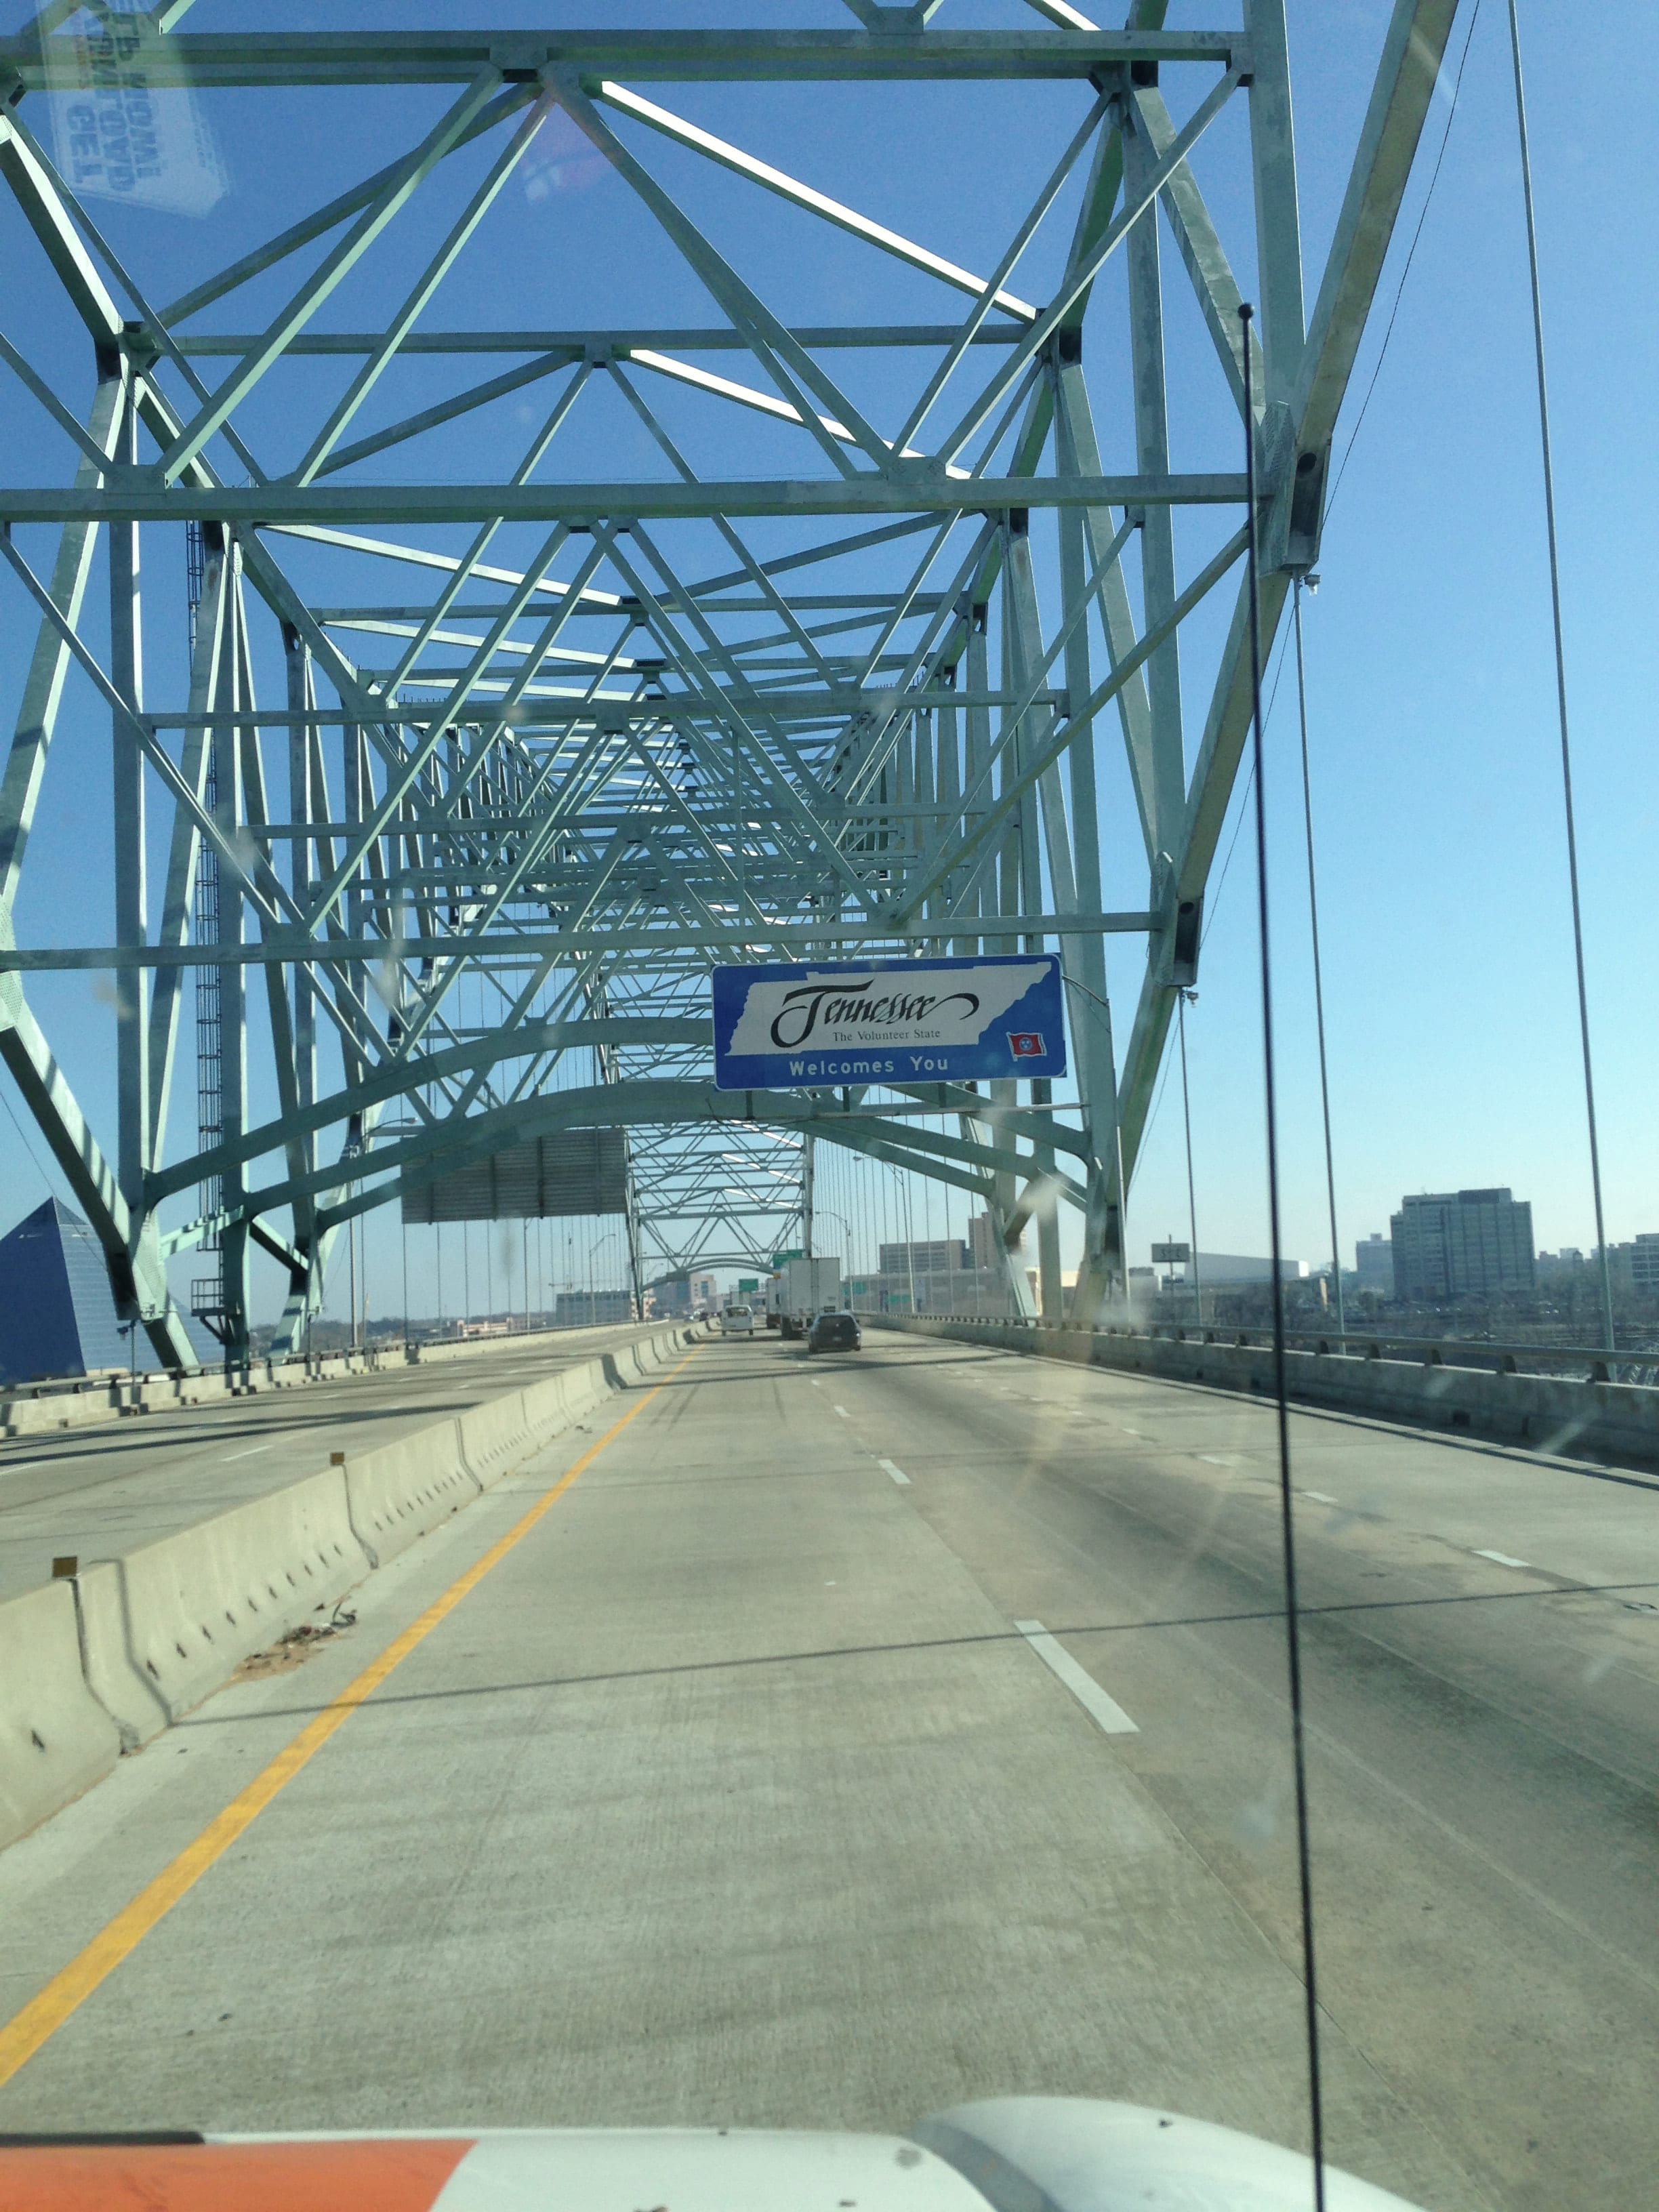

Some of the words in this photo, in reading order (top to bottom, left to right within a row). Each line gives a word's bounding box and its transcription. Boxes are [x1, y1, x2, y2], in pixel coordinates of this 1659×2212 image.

[771, 979, 979, 1048] Tennessee
[833, 1031, 853, 1042] The
[857, 1030, 909, 1040] Volunteer
[914, 1029, 941, 1038] State
[789, 1060, 894, 1076] Welcomes
[909, 1056, 947, 1071] You
